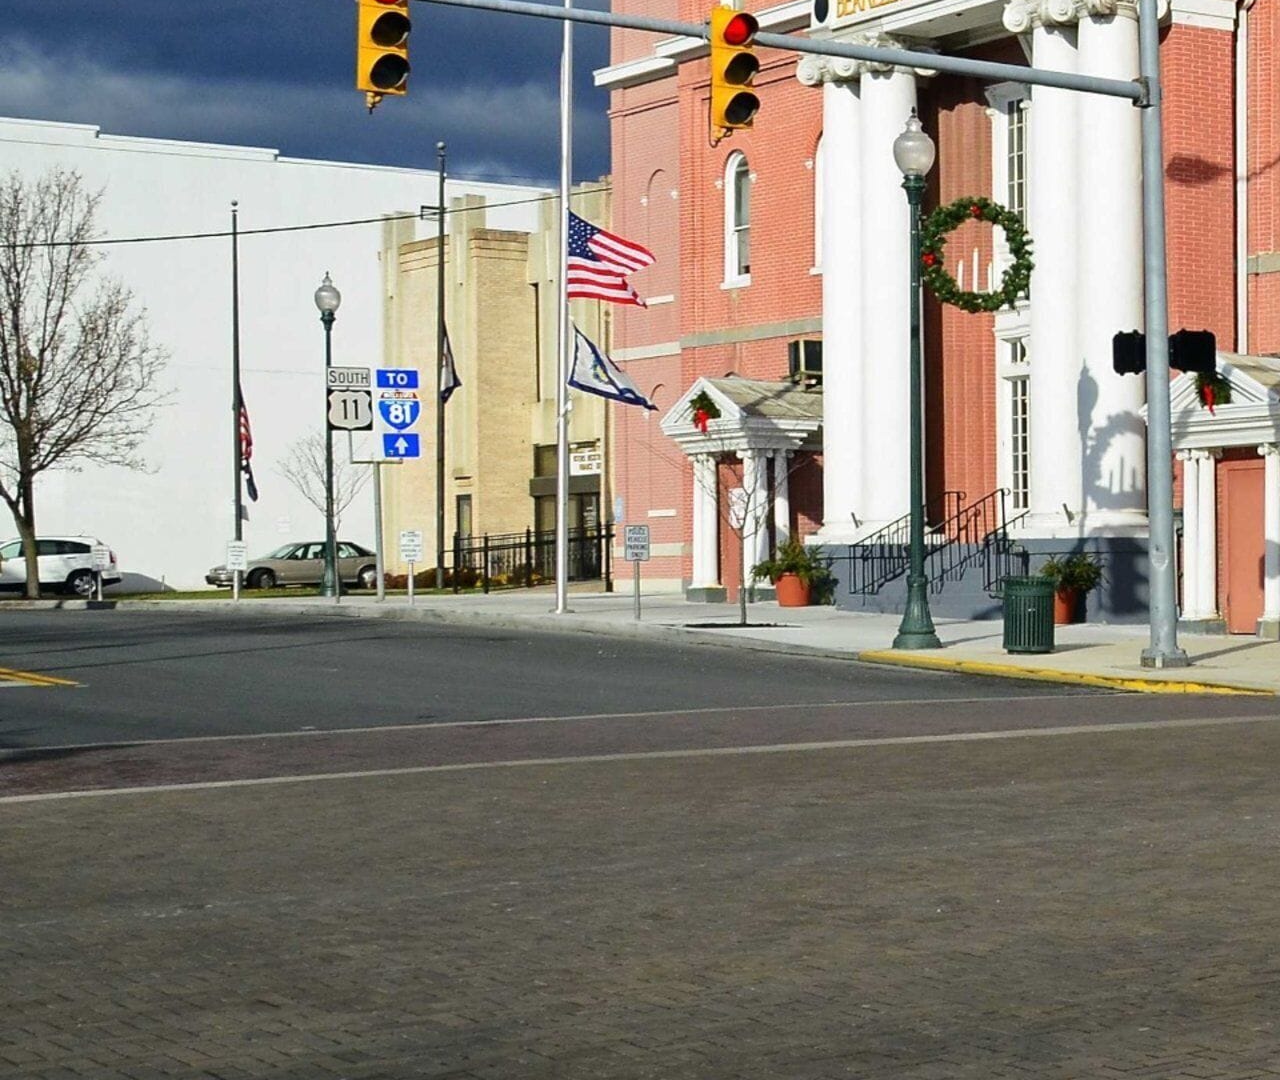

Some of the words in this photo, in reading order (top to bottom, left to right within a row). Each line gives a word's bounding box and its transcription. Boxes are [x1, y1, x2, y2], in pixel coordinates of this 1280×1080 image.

[329, 370, 369, 384] SOUTH
[386, 373, 408, 385] TO
[341, 399, 359, 420] 11
[389, 403, 412, 424] 81
